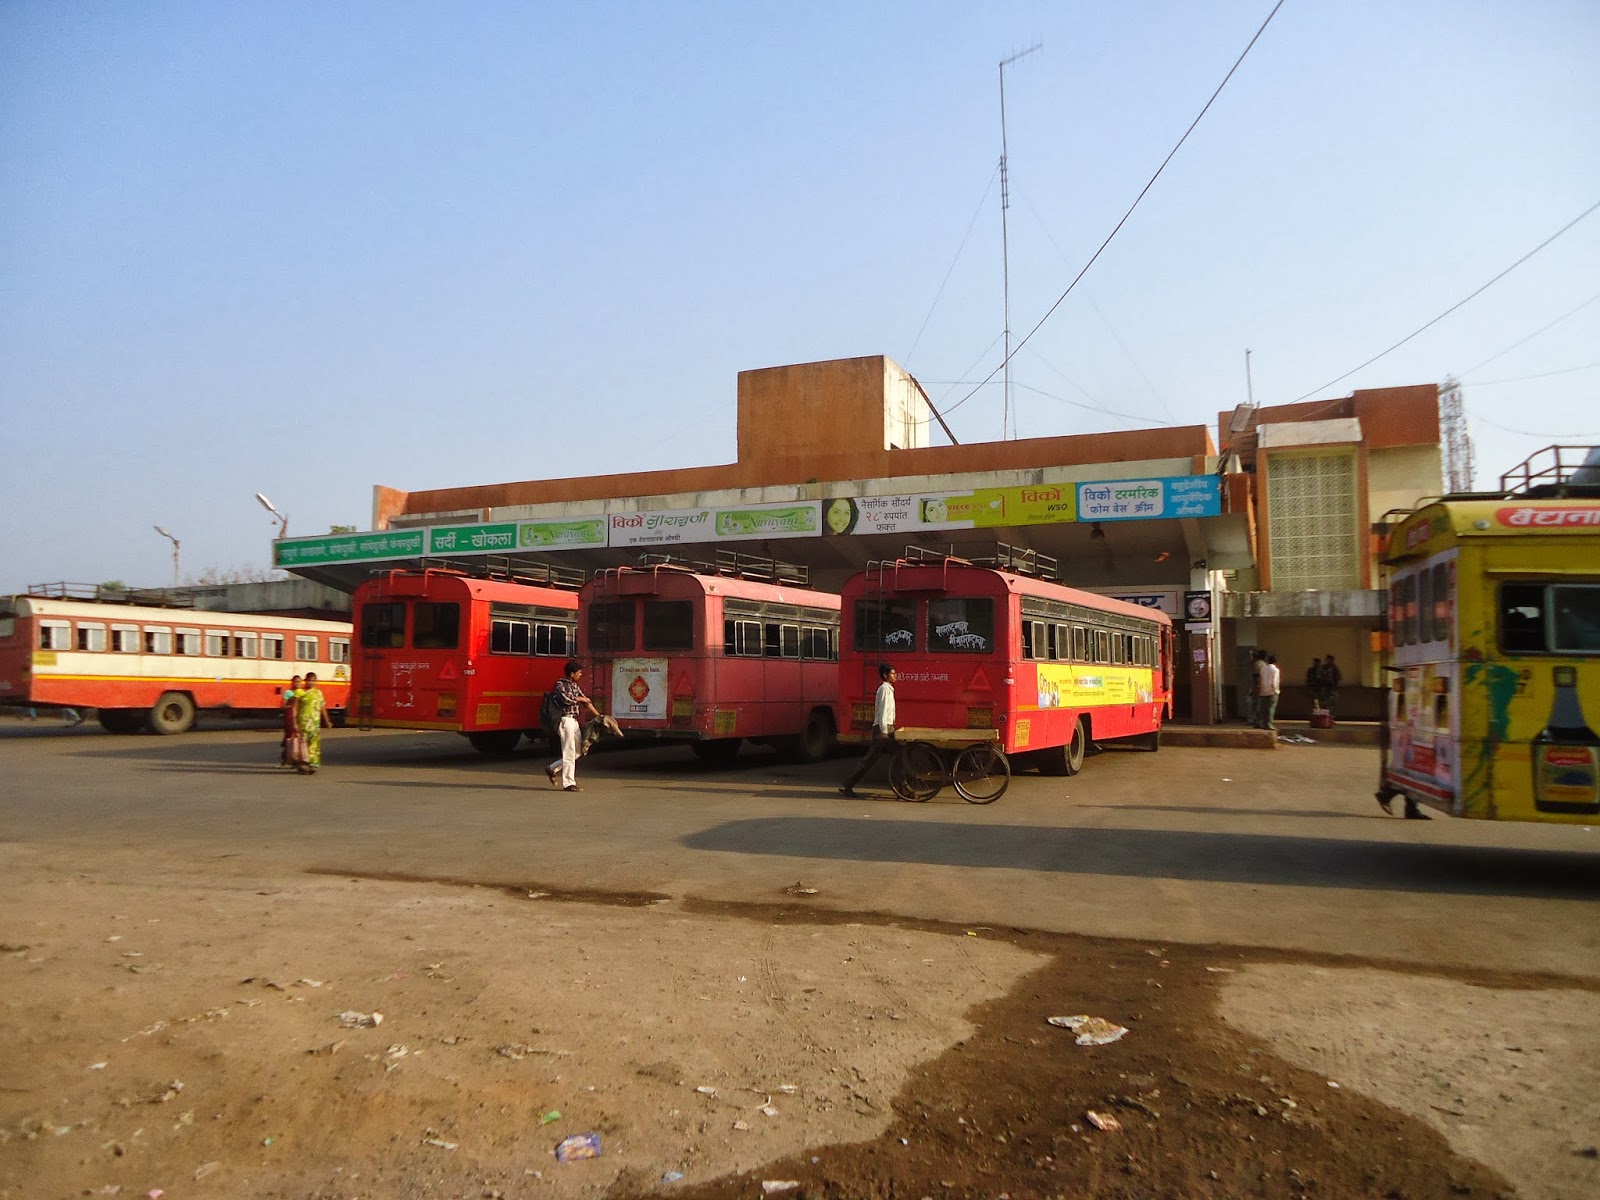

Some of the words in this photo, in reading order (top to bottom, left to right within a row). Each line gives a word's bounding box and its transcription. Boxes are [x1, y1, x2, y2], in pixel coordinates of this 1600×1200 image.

[1021, 487, 1061, 503] विको
[1085, 487, 1111, 501] विको
[1047, 503, 1068, 511] WSO
[612, 514, 644, 529] विको
[876, 523, 896, 532] फक्त
[472, 529, 512, 547] खोकला
